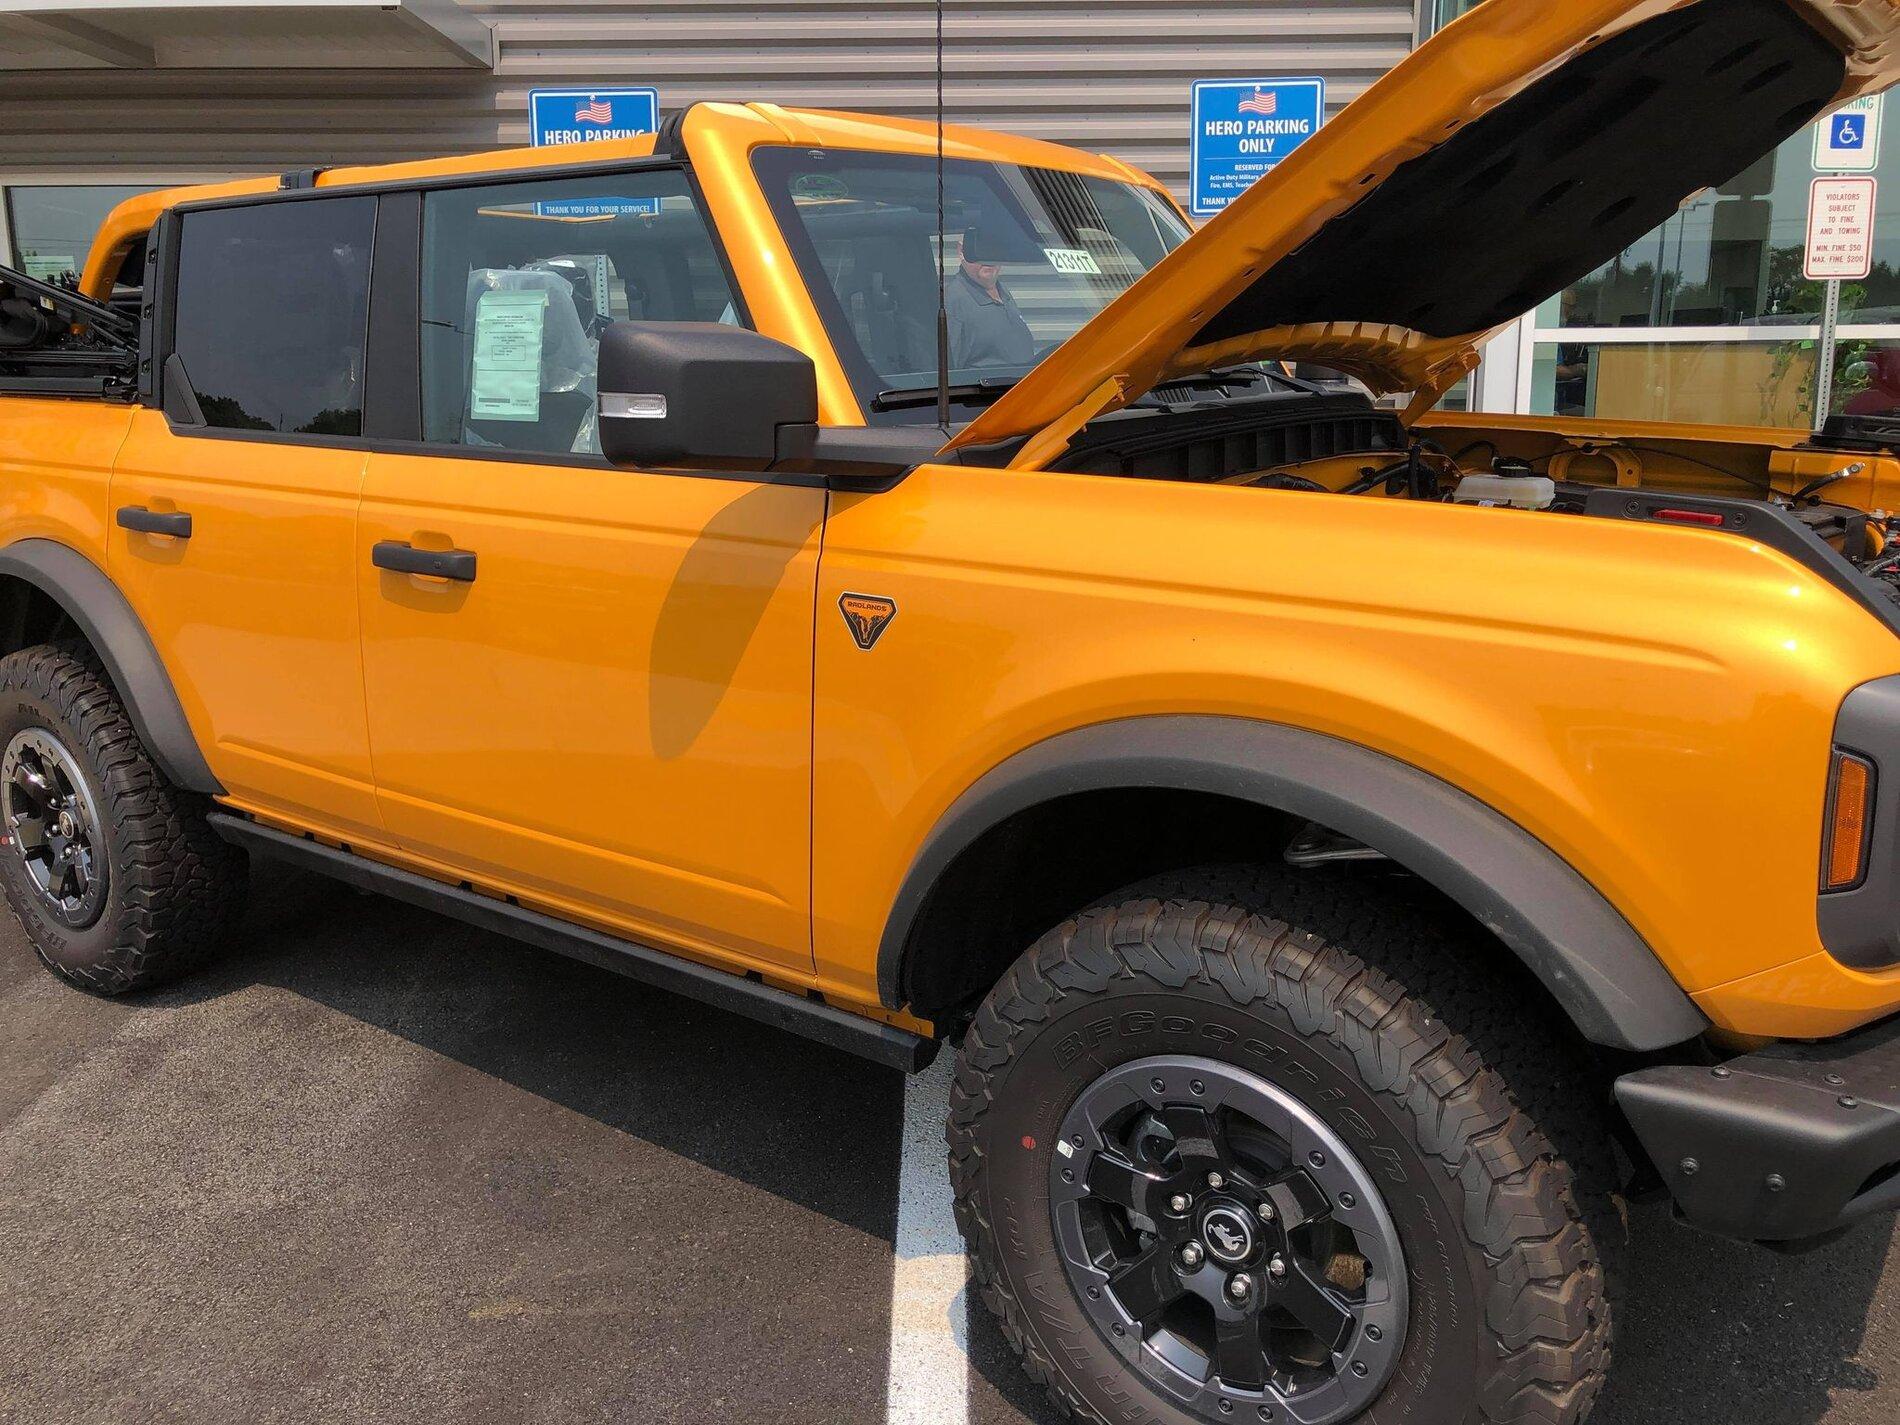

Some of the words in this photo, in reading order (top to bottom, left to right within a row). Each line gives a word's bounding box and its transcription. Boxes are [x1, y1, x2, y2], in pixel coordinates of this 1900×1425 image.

[1205, 121, 1242, 135] HERO
[1247, 119, 1309, 135] PARKING
[545, 130, 581, 144] HERO
[1239, 139, 1275, 153] ONLY
[1202, 197, 1226, 206] THANK
[1825, 193, 1860, 201] VIOLATORS
[546, 206, 569, 214] THANK
[620, 205, 650, 213] SERVICE!
[1828, 204, 1856, 212] SUBJECT
[1820, 227, 1833, 235] AND
[1838, 227, 1861, 235] TOWING
[1832, 244, 1846, 252] FINE
[1849, 244, 1861, 252] $50
[1049, 250, 1095, 272] 21311T
[1829, 255, 1844, 263] FINE
[1847, 255, 1864, 263] $200
